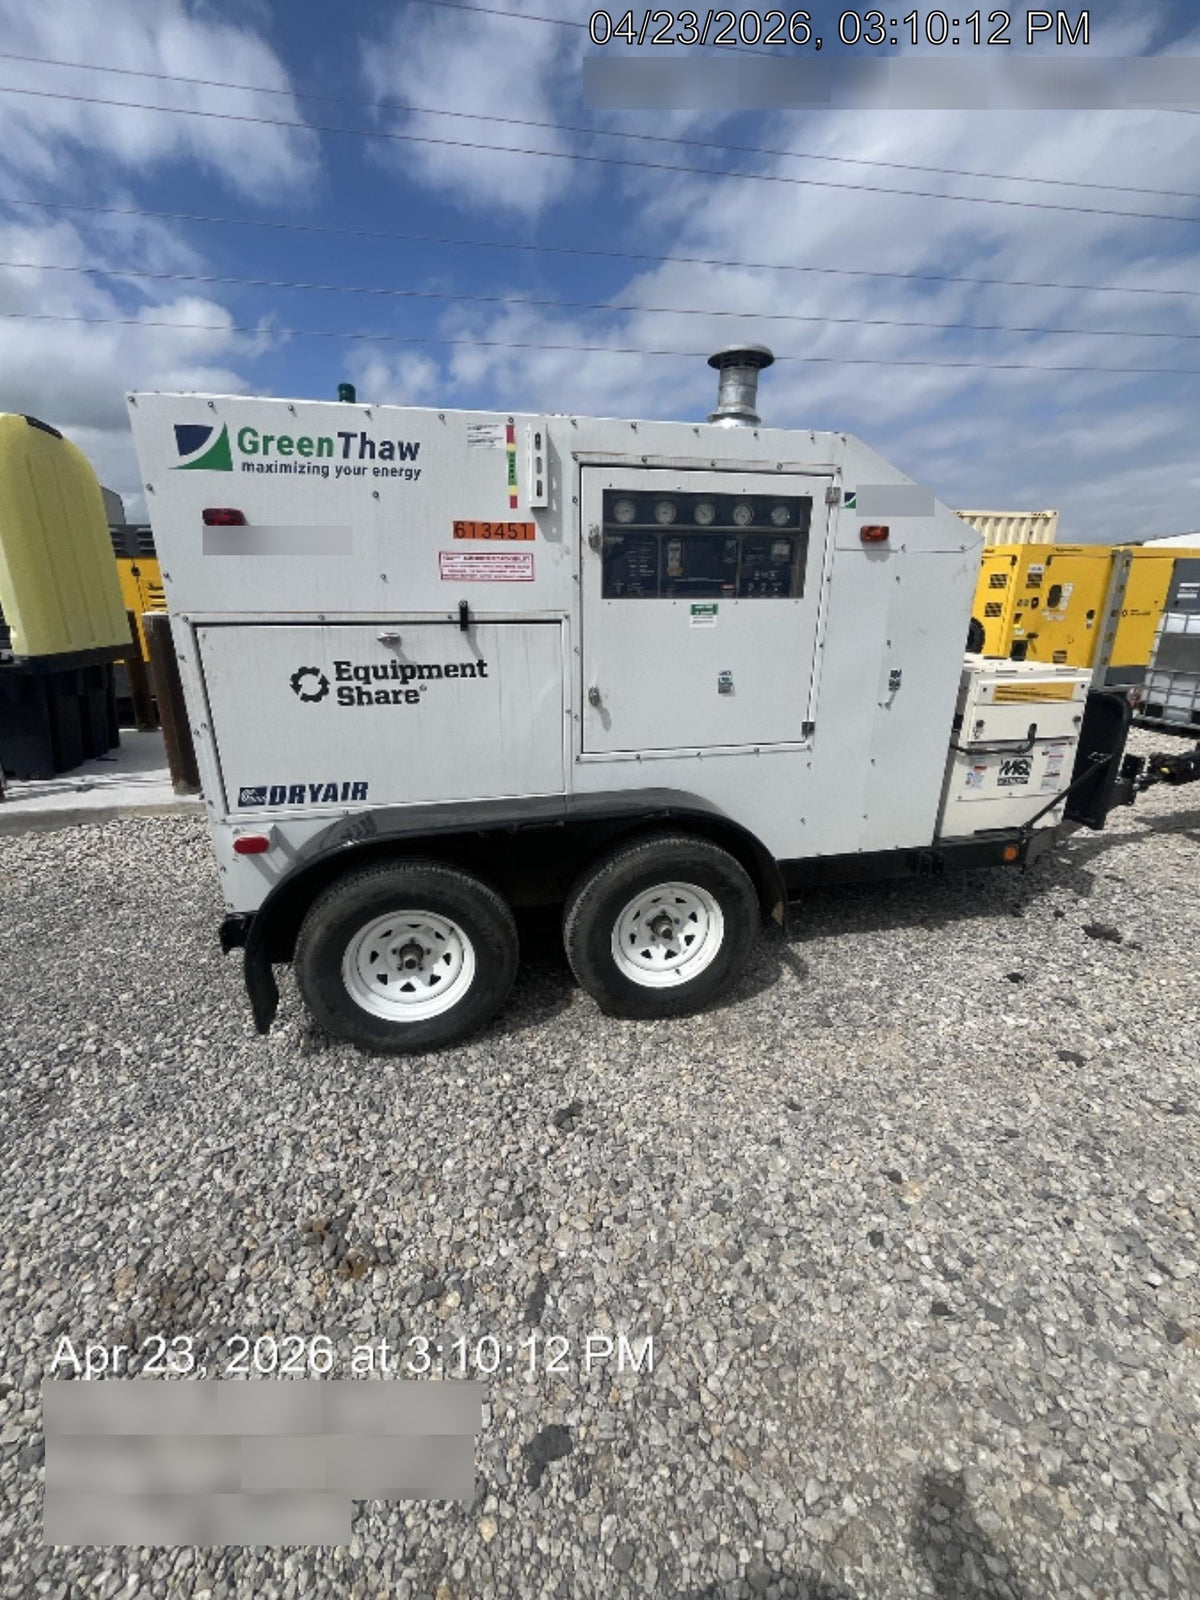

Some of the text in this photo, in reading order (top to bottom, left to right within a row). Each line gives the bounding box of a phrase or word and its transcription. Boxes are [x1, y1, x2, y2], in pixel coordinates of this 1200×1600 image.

[237, 426, 421, 461] GreenThaw
[241, 460, 423, 481] maximizing your energy
[455, 522, 529, 540] 613451
[333, 659, 489, 685] Equipment
[268, 781, 369, 806] DRYAIR
